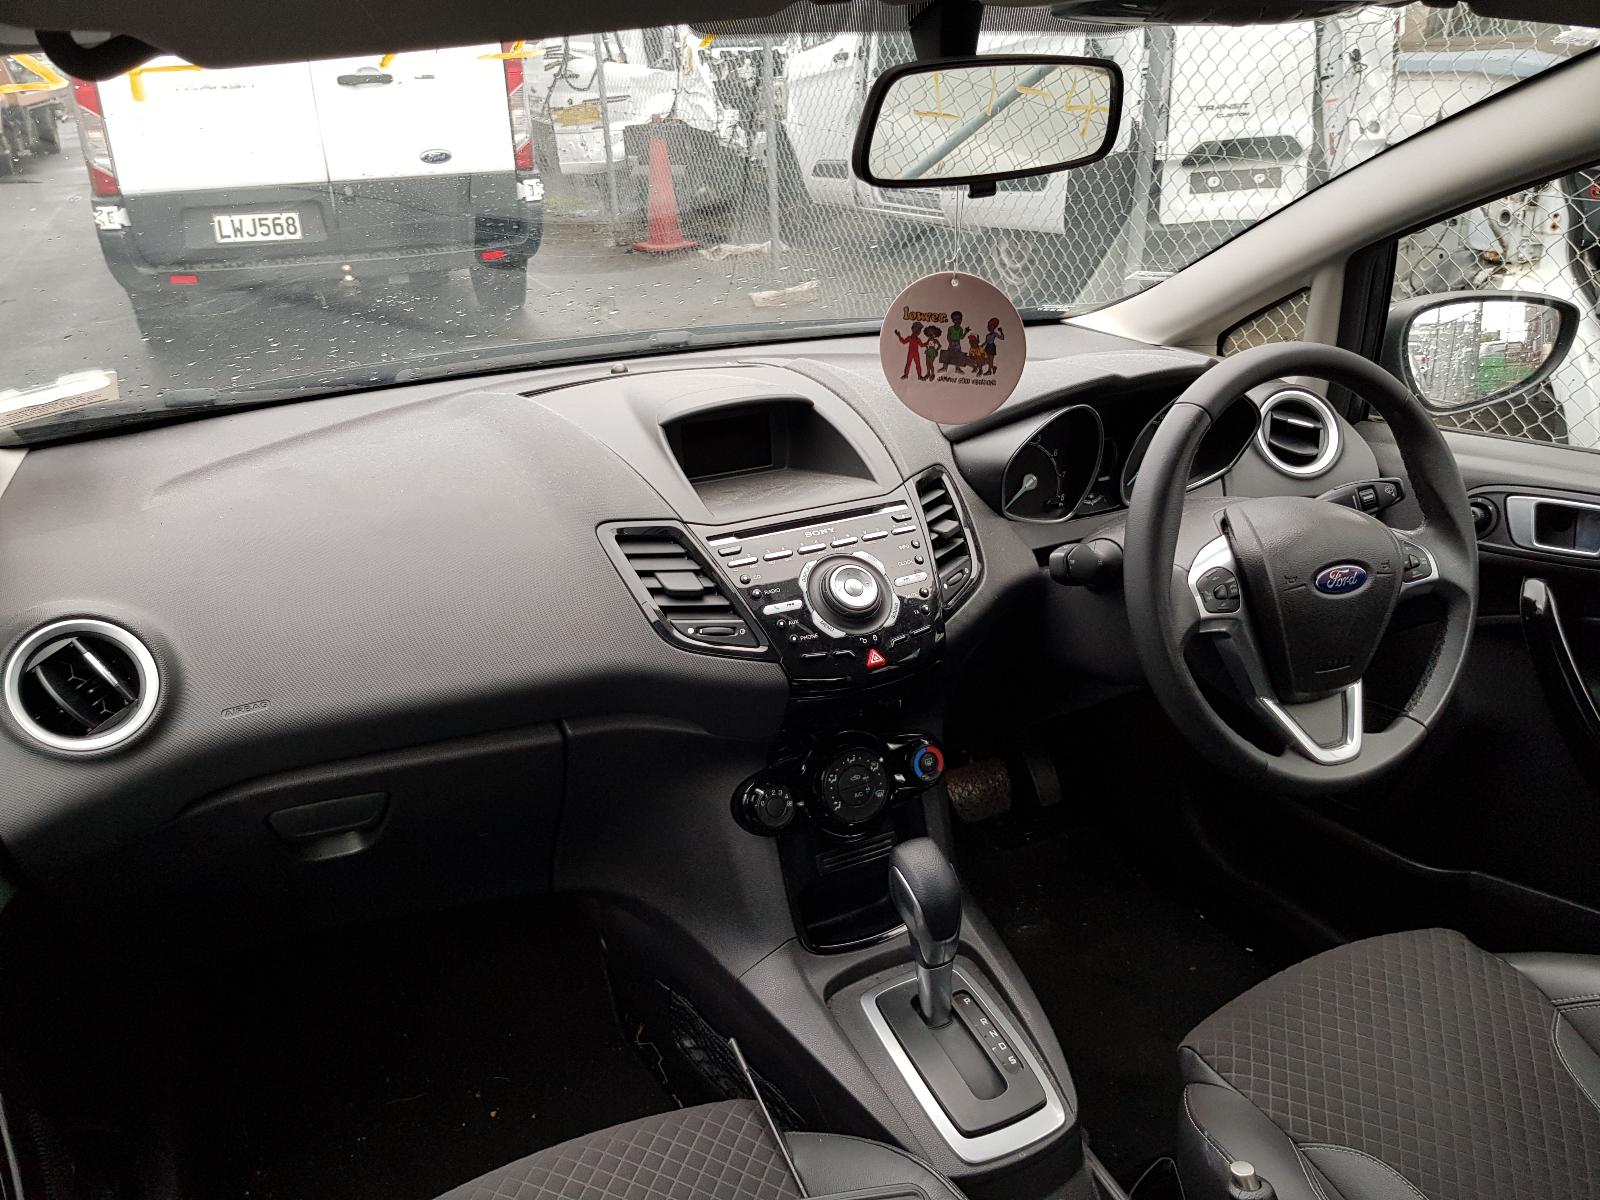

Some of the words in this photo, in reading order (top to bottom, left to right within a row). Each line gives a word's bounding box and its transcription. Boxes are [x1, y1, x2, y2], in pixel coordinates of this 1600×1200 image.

[217, 216, 298, 240] LWJ568
[804, 527, 836, 538] SONY
[763, 587, 781, 595] RADIO
[800, 632, 819, 641] PHONE
[998, 1042, 1007, 1050] D
[1008, 1056, 1017, 1065] S
